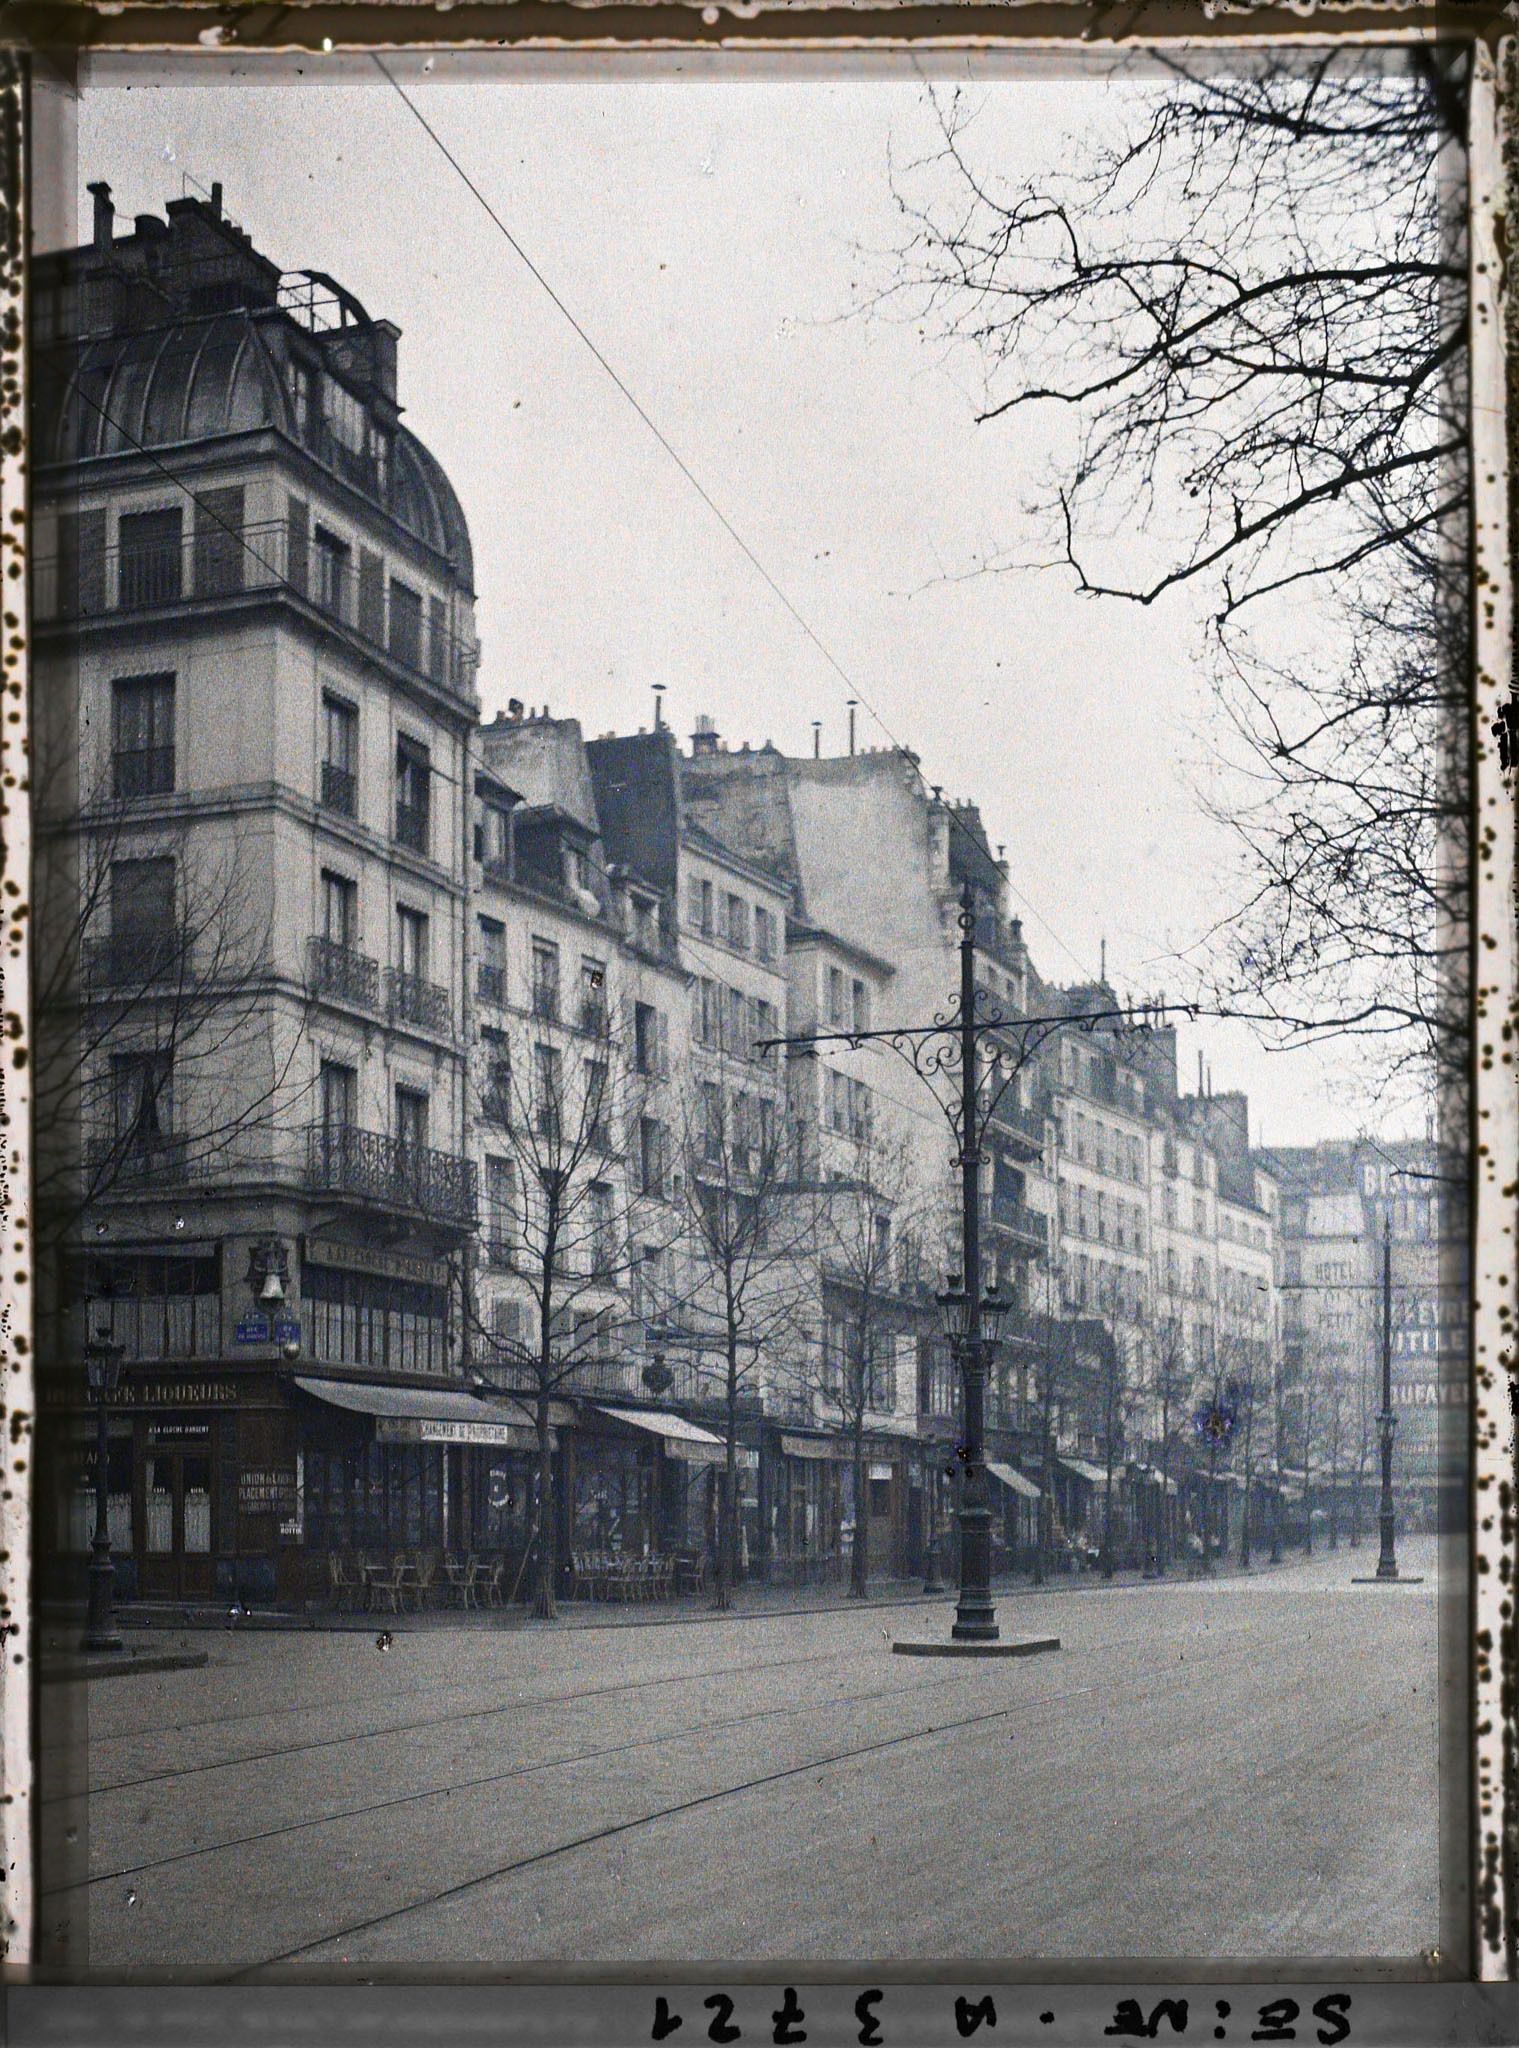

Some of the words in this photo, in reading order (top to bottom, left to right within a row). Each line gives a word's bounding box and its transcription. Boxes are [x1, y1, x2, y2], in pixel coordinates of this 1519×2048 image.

[144, 1383, 236, 1402] LIQUEURS
[240, 1473, 265, 1485] UNION
[238, 1486, 278, 1500] PLACEMENT
[955, 1996, 996, 2037] A
